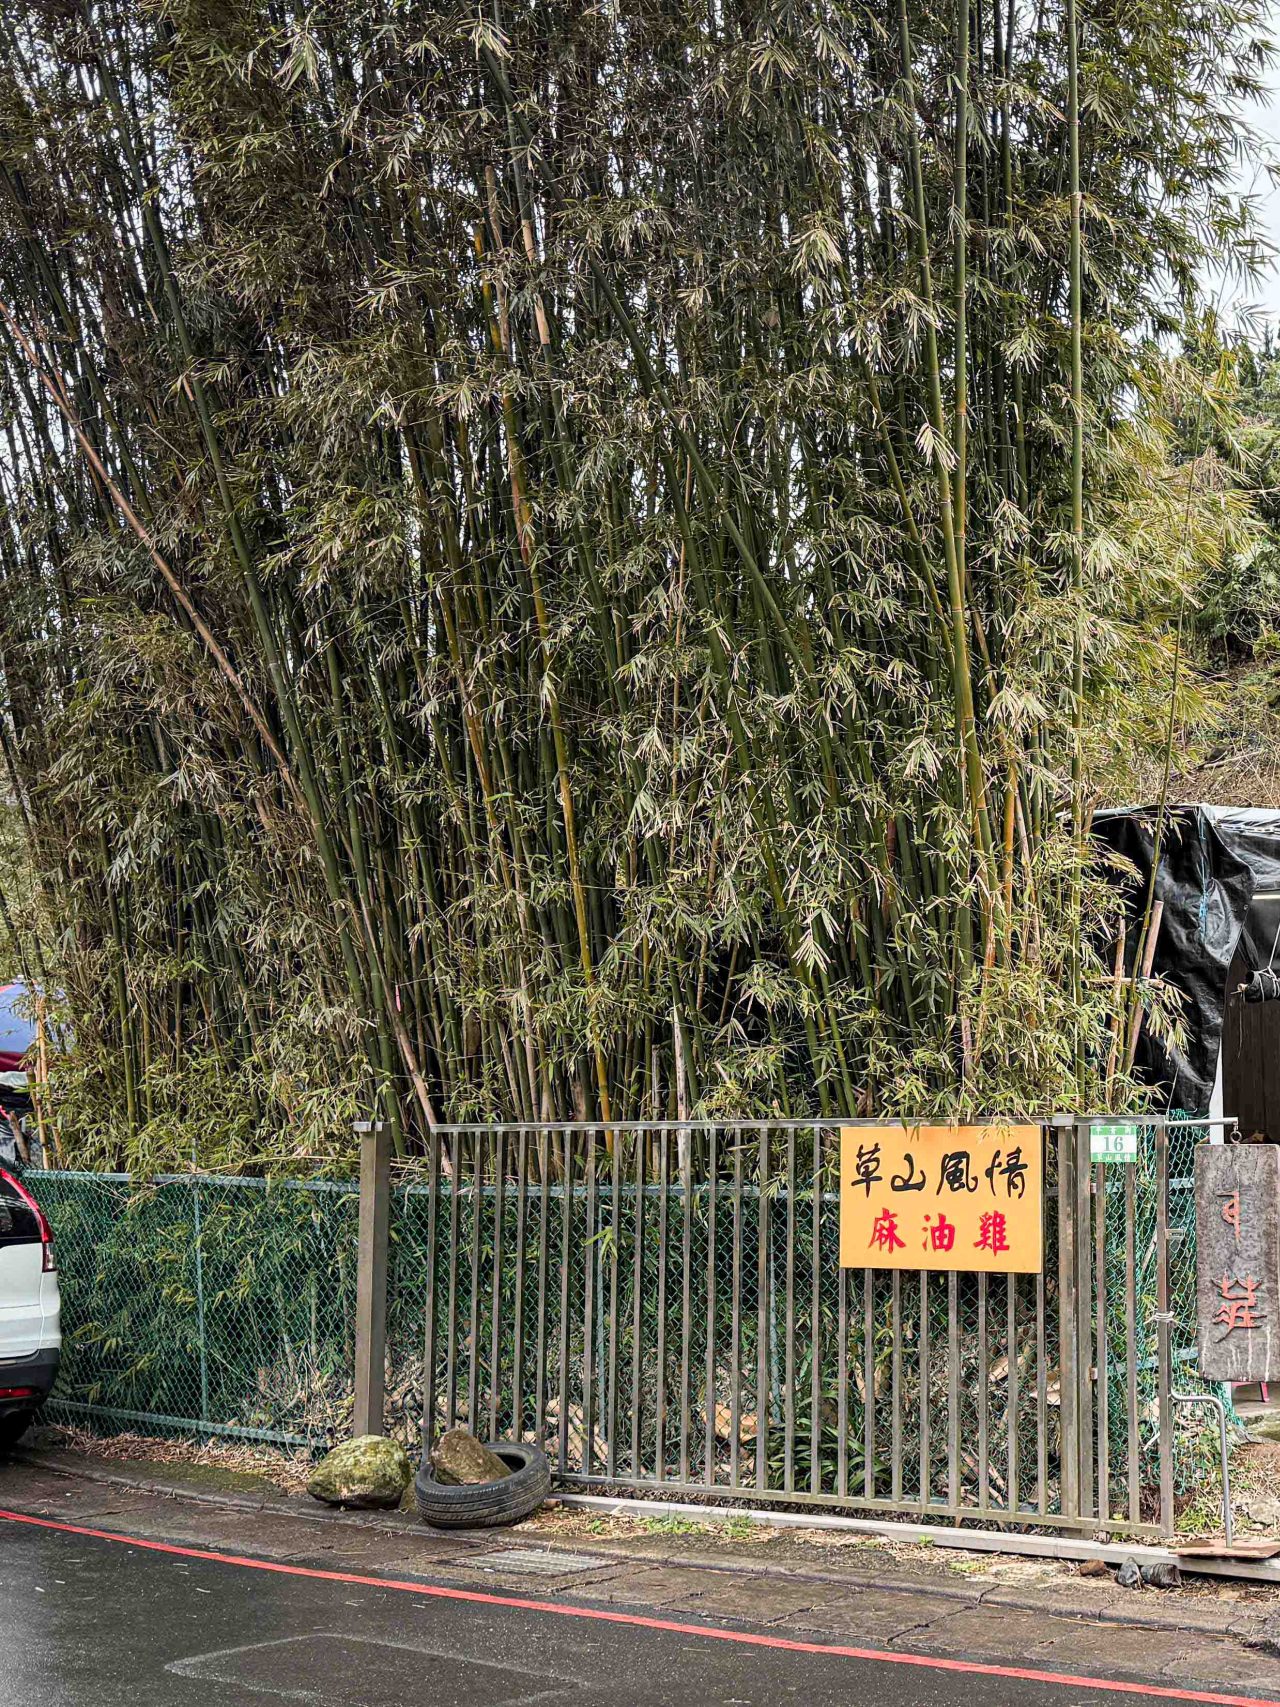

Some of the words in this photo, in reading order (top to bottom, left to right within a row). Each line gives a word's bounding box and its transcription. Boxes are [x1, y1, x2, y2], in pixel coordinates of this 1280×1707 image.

[1104, 1136, 1124, 1152] 16
[851, 1142, 1029, 1200] 草山風情
[868, 1207, 1010, 1257] 麻油雞
